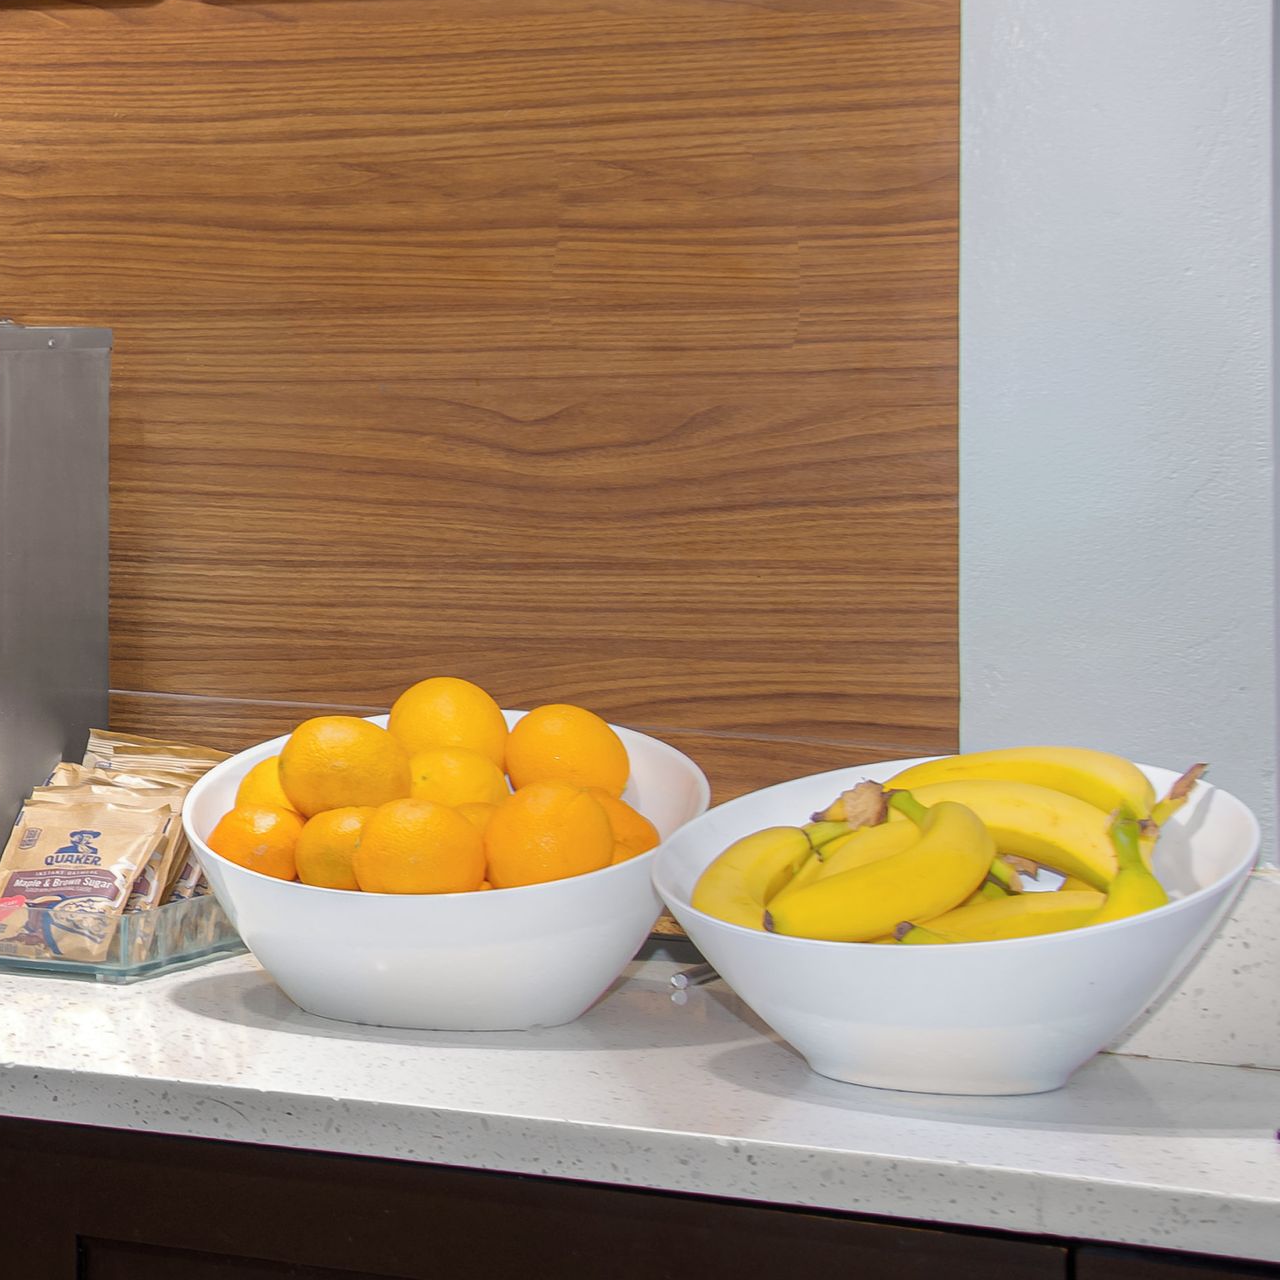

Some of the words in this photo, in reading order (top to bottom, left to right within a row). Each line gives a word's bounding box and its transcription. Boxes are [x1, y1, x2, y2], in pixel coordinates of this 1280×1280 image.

[44, 854, 102, 866] QUAKER
[13, 879, 42, 888] Maple
[43, 879, 51, 888] &
[52, 878, 81, 888] Brown
[82, 877, 114, 889] Sugar
